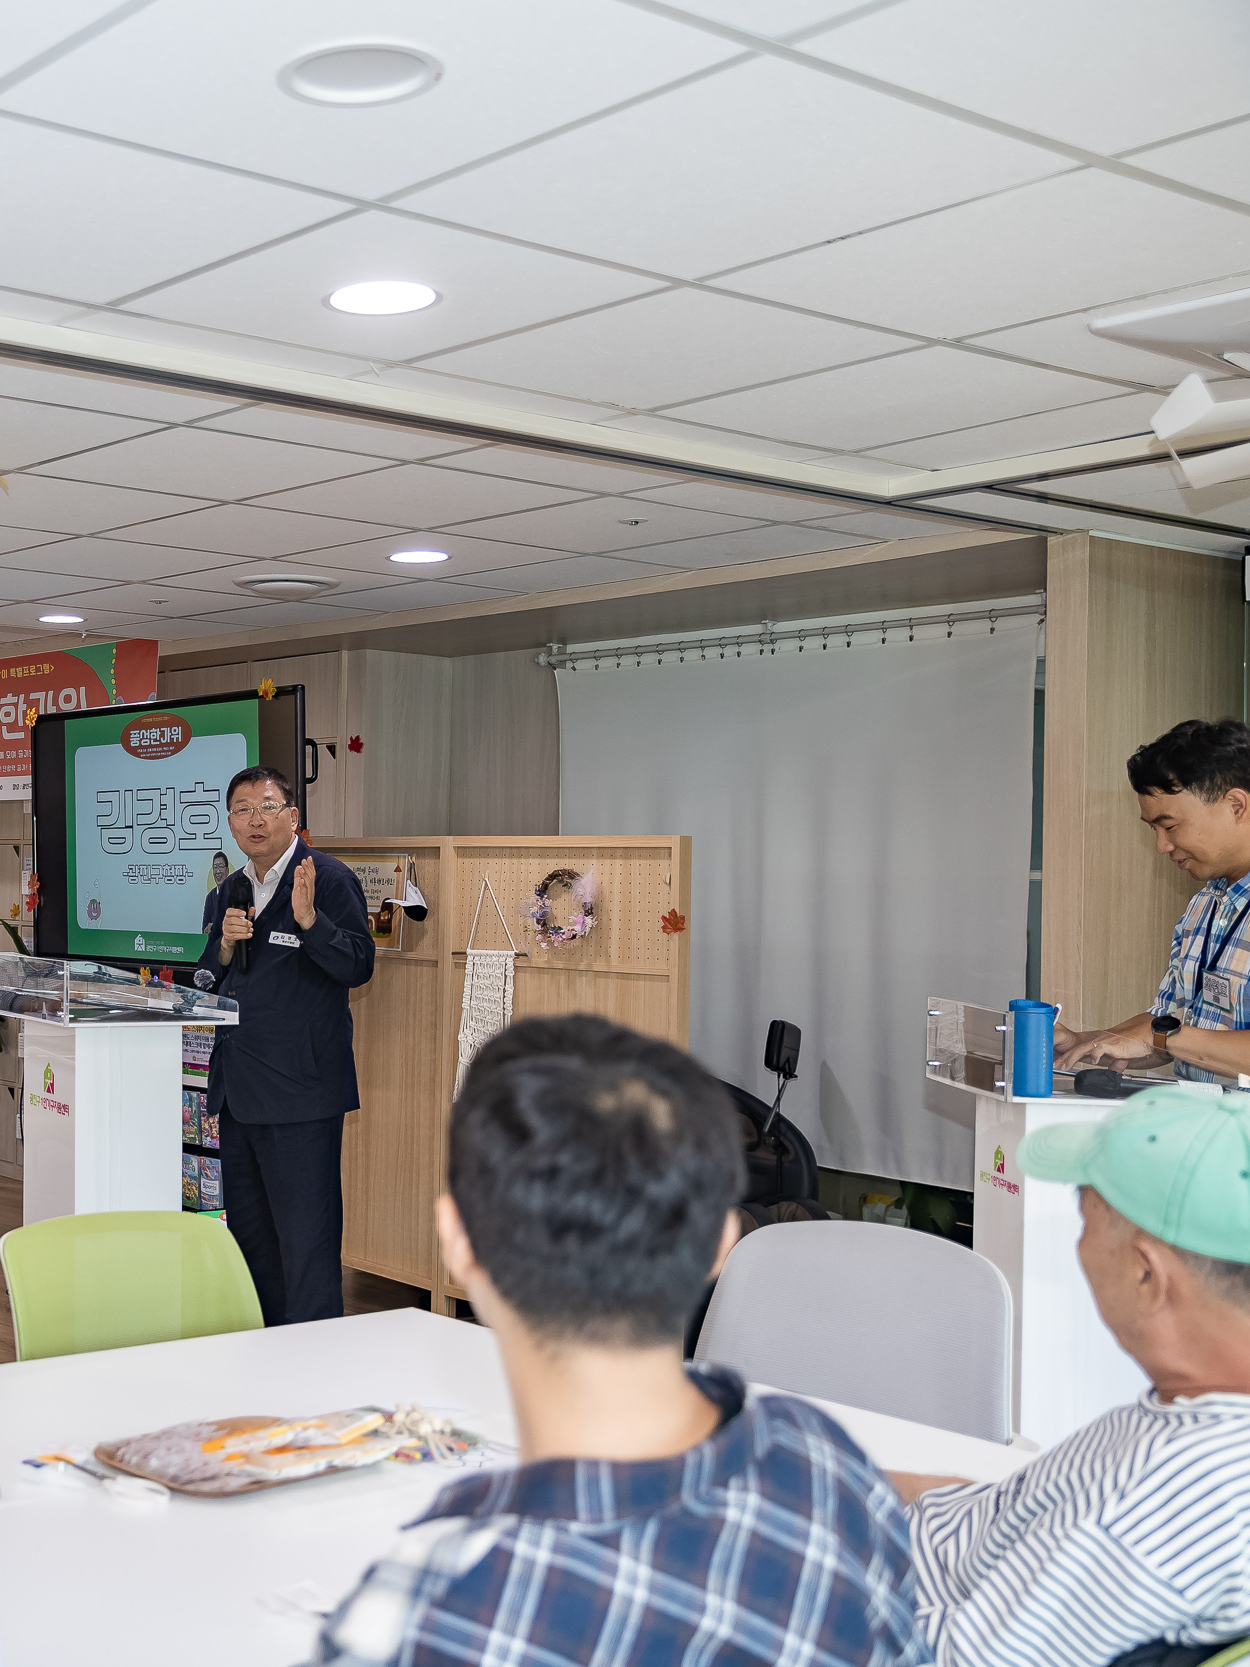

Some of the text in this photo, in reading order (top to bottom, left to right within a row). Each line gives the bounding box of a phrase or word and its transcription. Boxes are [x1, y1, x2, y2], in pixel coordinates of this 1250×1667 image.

[9, 663, 55, 679] 특별프로그램>
[130, 726, 182, 747] 풍성한가위
[6, 750, 17, 759] 모여
[96, 781, 223, 855] 김경호
[122, 863, 194, 885] -광진구청장-
[182, 1040, 203, 1049] 내데스크에
[29, 1093, 70, 1117] 광진구 1인가구지원센터
[202, 1182, 218, 1191] Sports
[979, 1170, 1019, 1197] 광진구 1인가구지원센터
